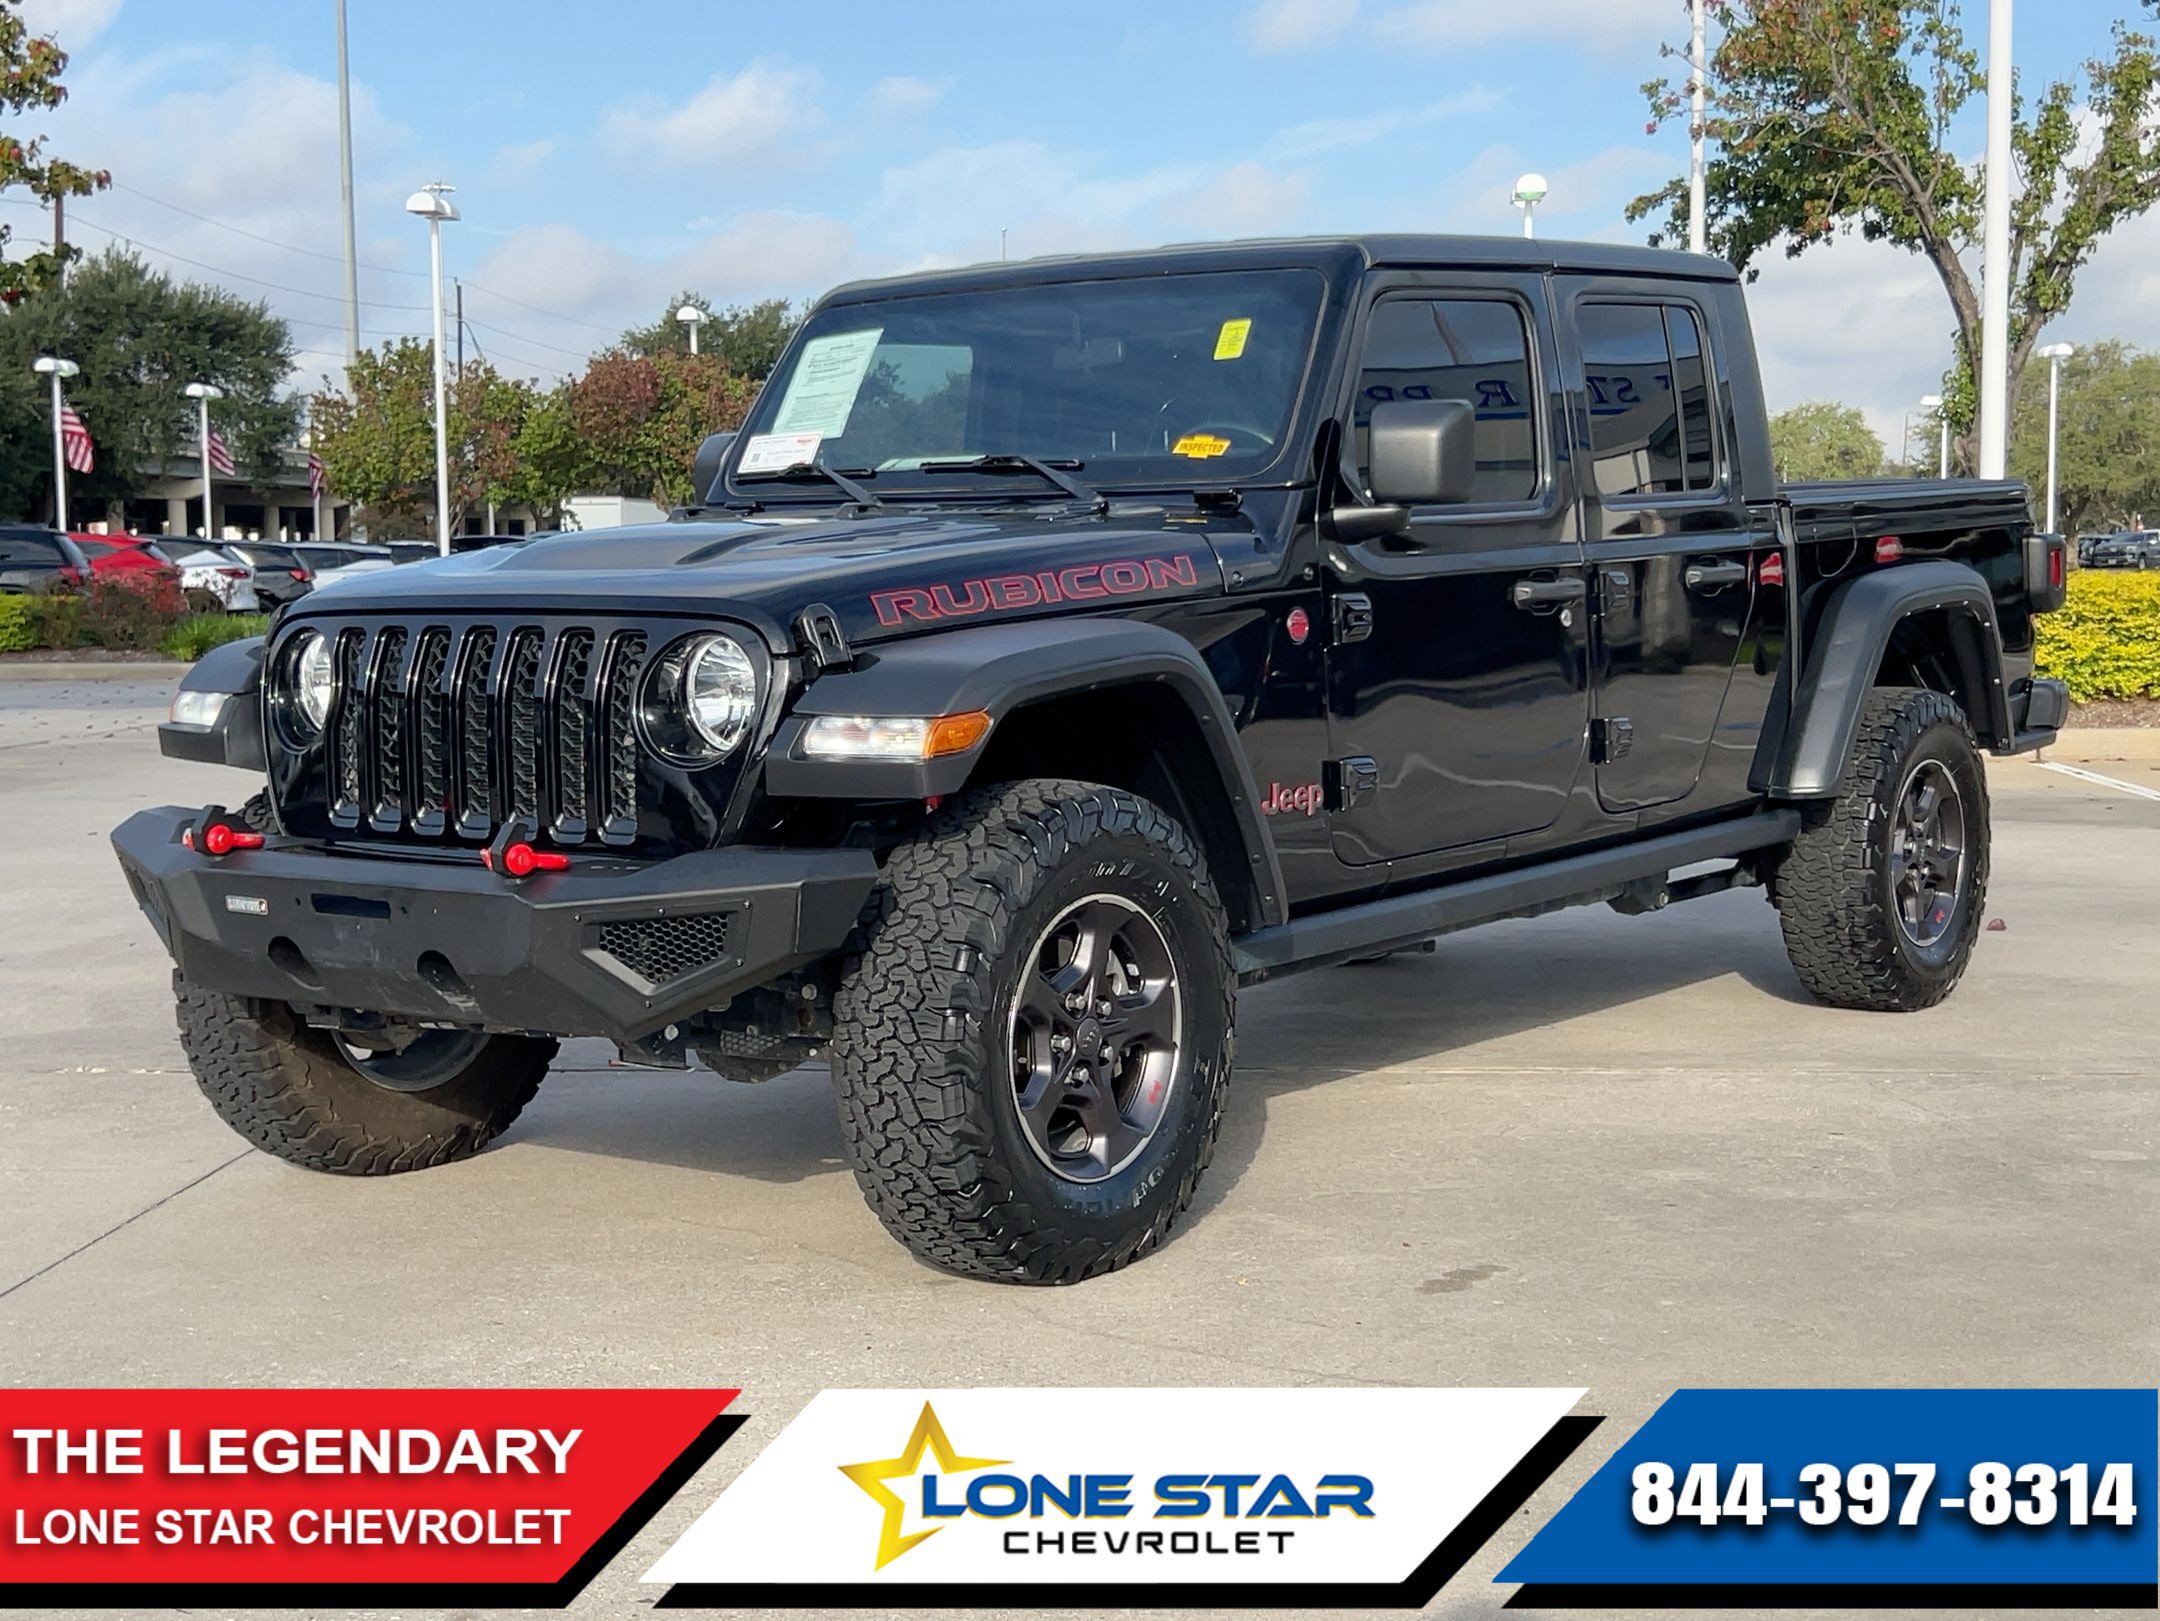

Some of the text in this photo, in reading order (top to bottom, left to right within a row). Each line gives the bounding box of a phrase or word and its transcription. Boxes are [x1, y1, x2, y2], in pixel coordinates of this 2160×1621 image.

[1178, 442, 1224, 454] INSPECTED
[871, 556, 1198, 627] RUBICON
[1261, 782, 1324, 817] Jeep
